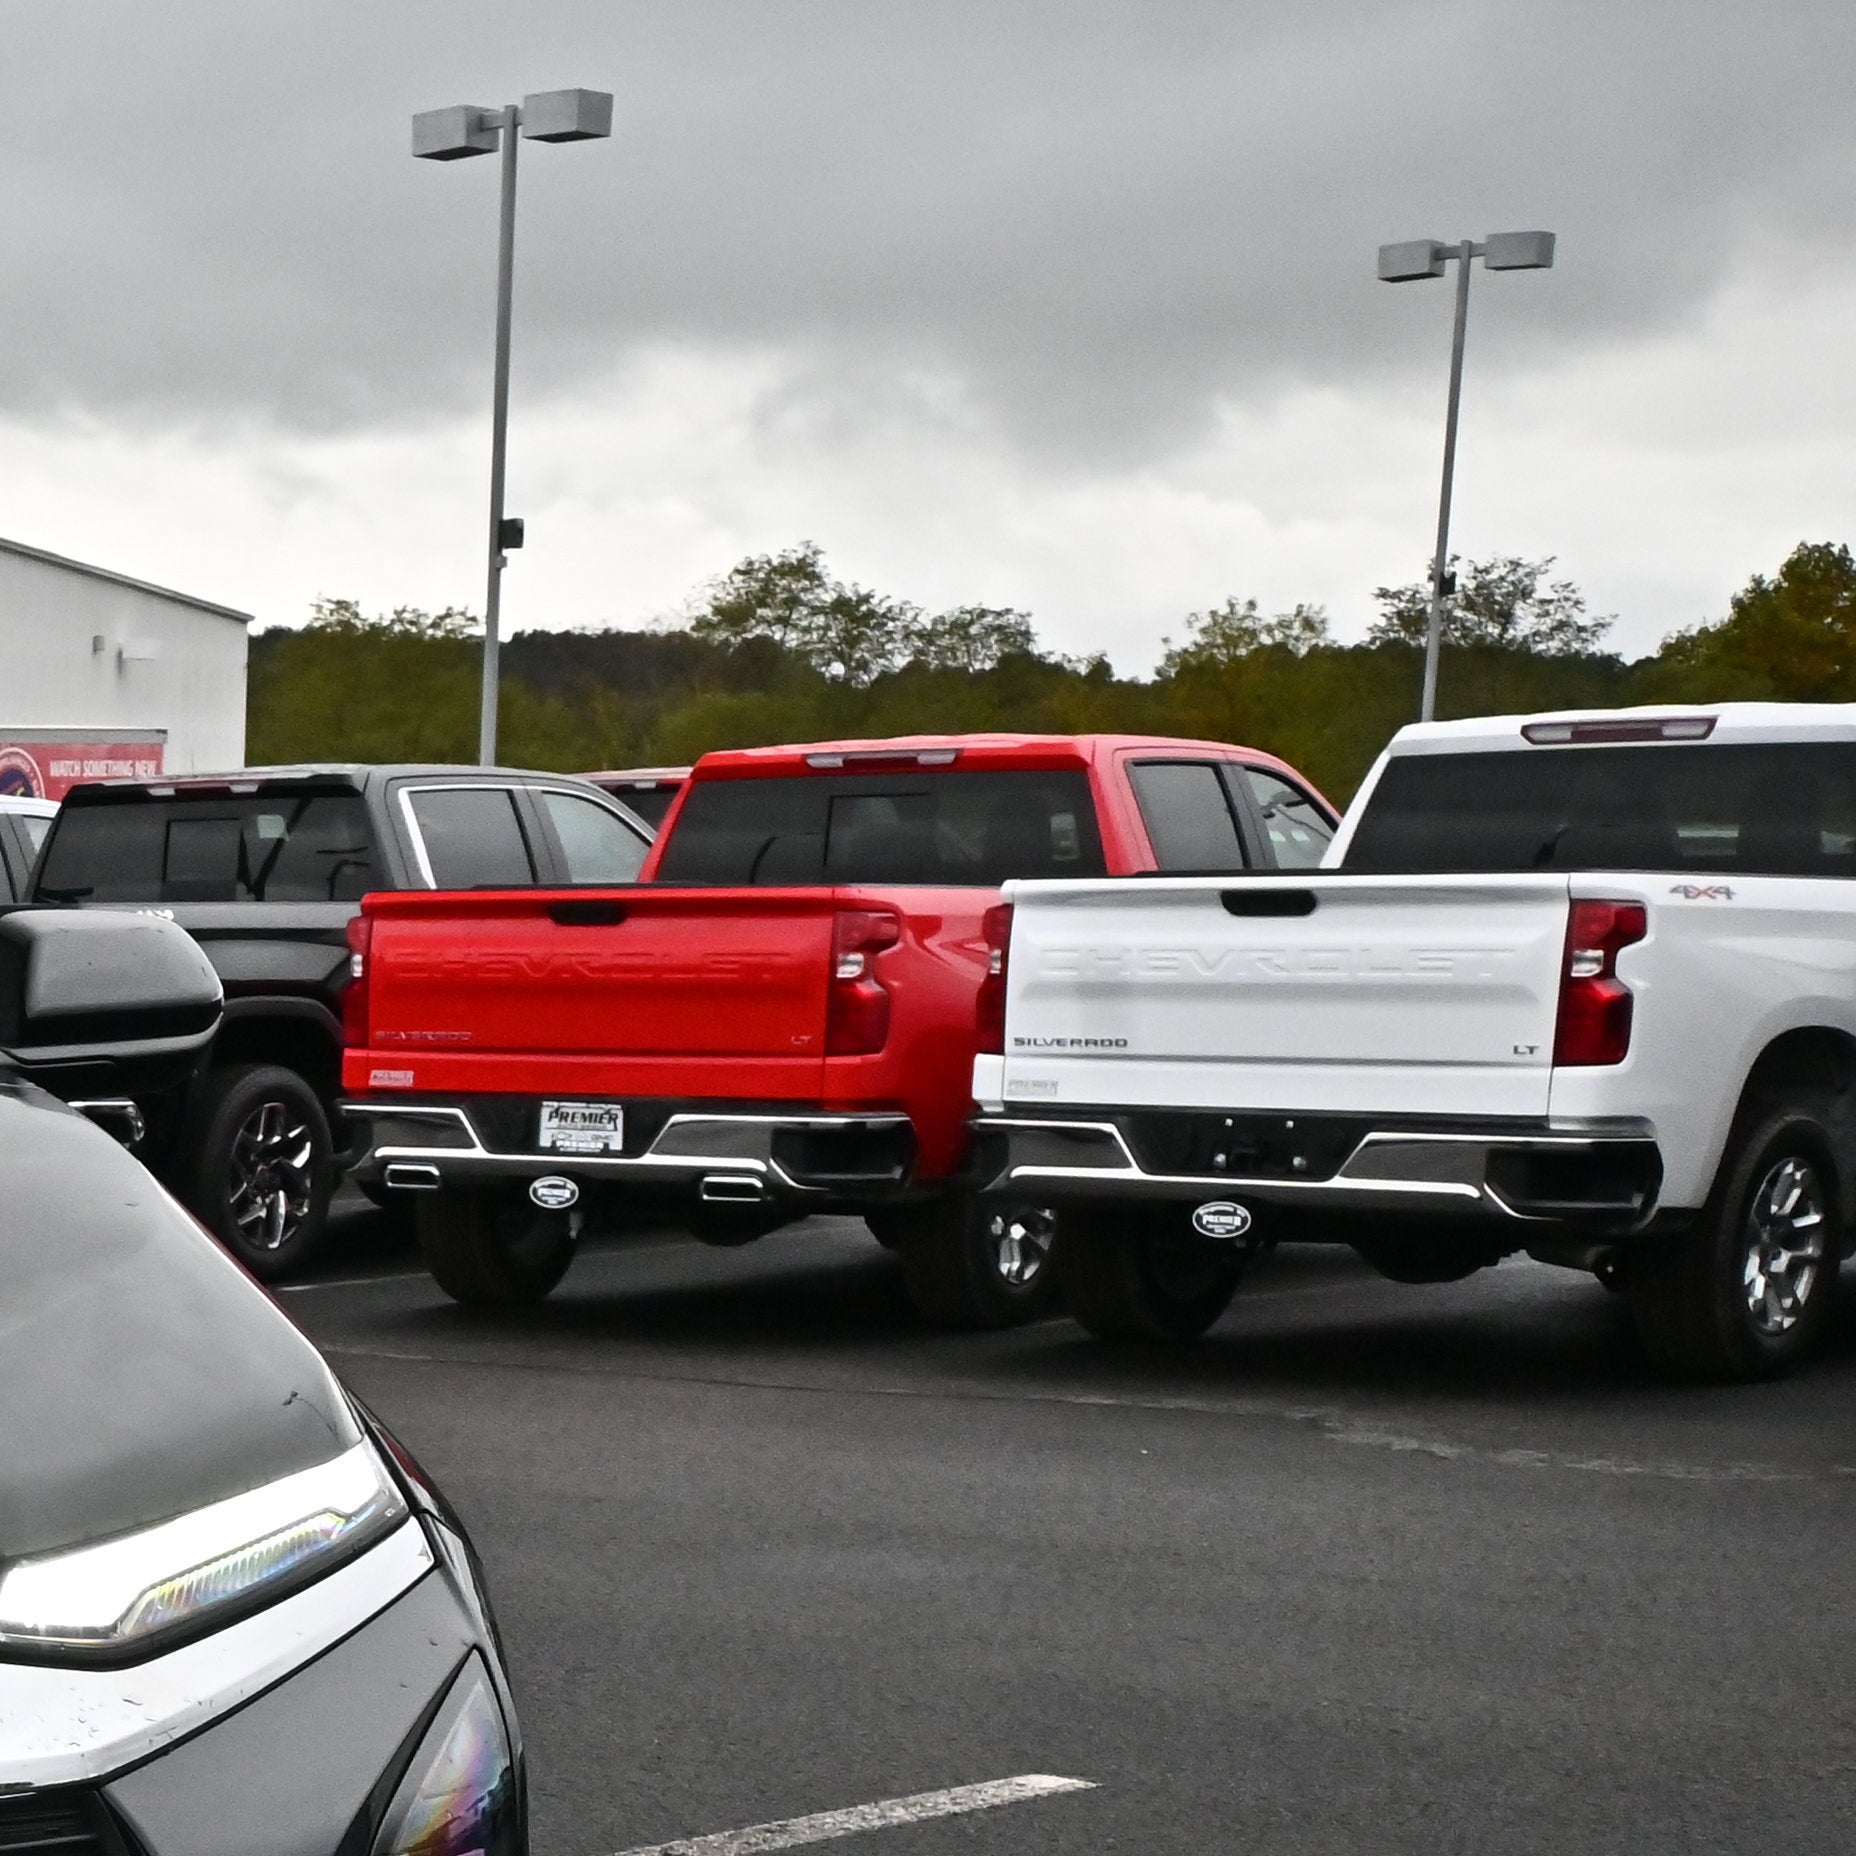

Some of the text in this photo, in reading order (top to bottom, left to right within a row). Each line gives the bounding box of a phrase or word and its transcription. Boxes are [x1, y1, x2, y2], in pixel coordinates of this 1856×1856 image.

[1038, 947, 1516, 977] CHEVROLET
[1013, 1037, 1128, 1048] SILVERADO
[1513, 1045, 1539, 1055] LT
[547, 1108, 619, 1129] PREMIER
